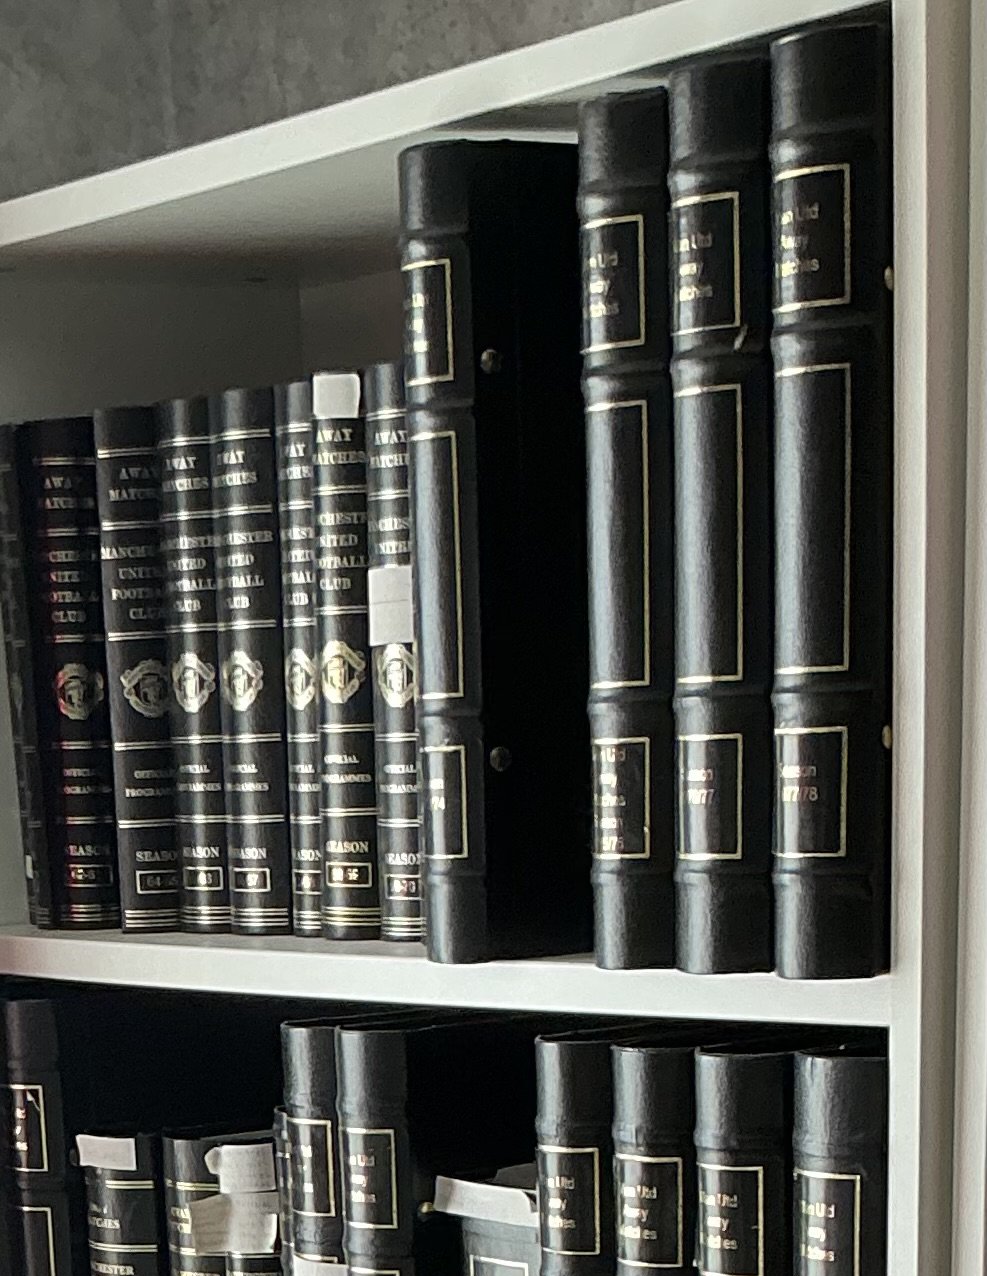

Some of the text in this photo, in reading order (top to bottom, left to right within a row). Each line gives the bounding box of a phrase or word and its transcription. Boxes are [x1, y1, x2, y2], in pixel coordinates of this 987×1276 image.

[316, 428, 353, 443] AWAY
[319, 577, 352, 591] CLUB
[325, 840, 369, 855] SEASON
